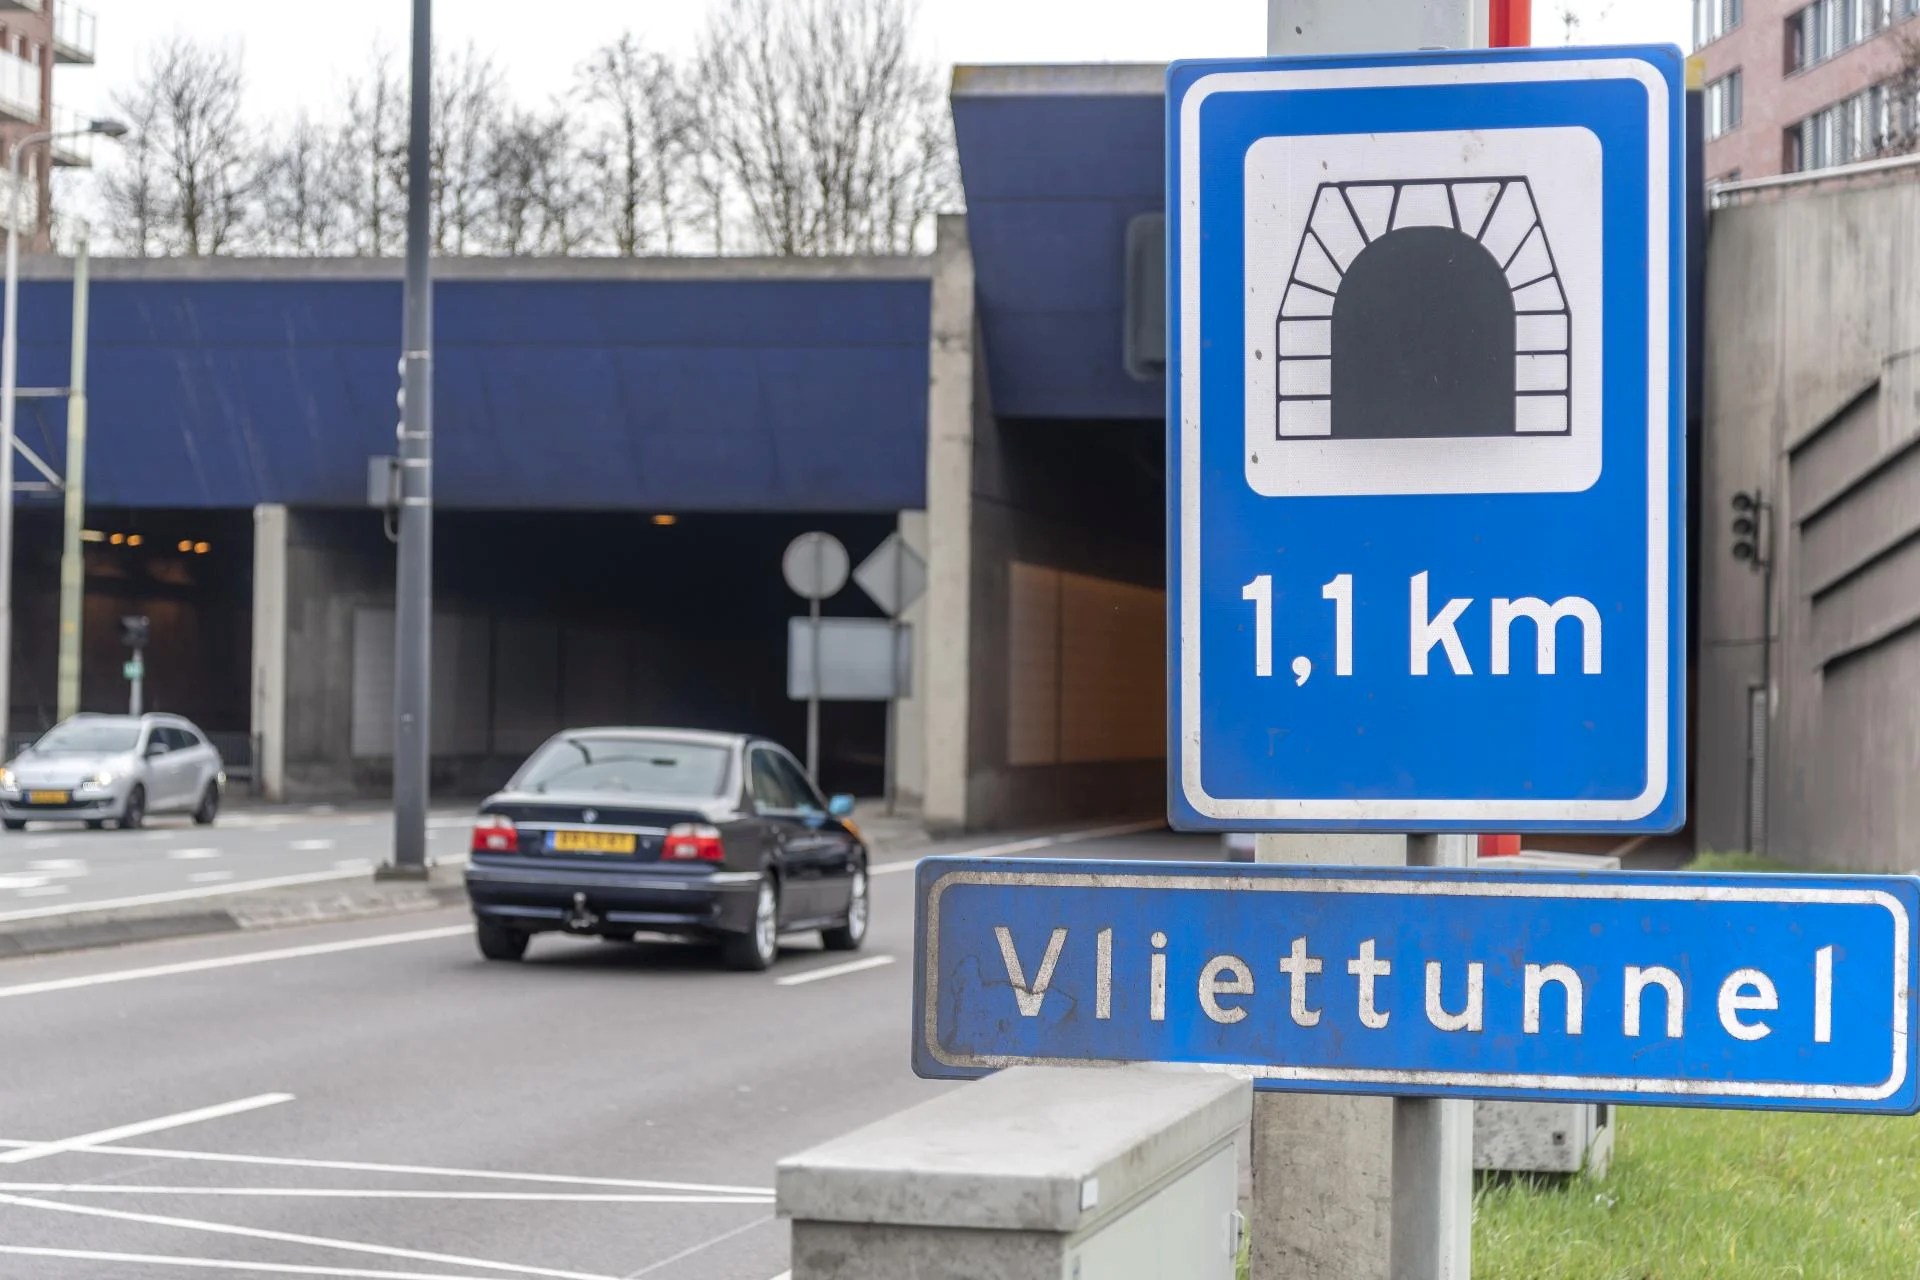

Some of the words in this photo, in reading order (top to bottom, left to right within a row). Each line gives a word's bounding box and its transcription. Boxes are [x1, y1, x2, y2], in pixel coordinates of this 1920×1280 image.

[1242, 573, 1353, 687] 1,1
[1410, 570, 1602, 675] km
[994, 926, 1833, 1043] Vliettunnel
